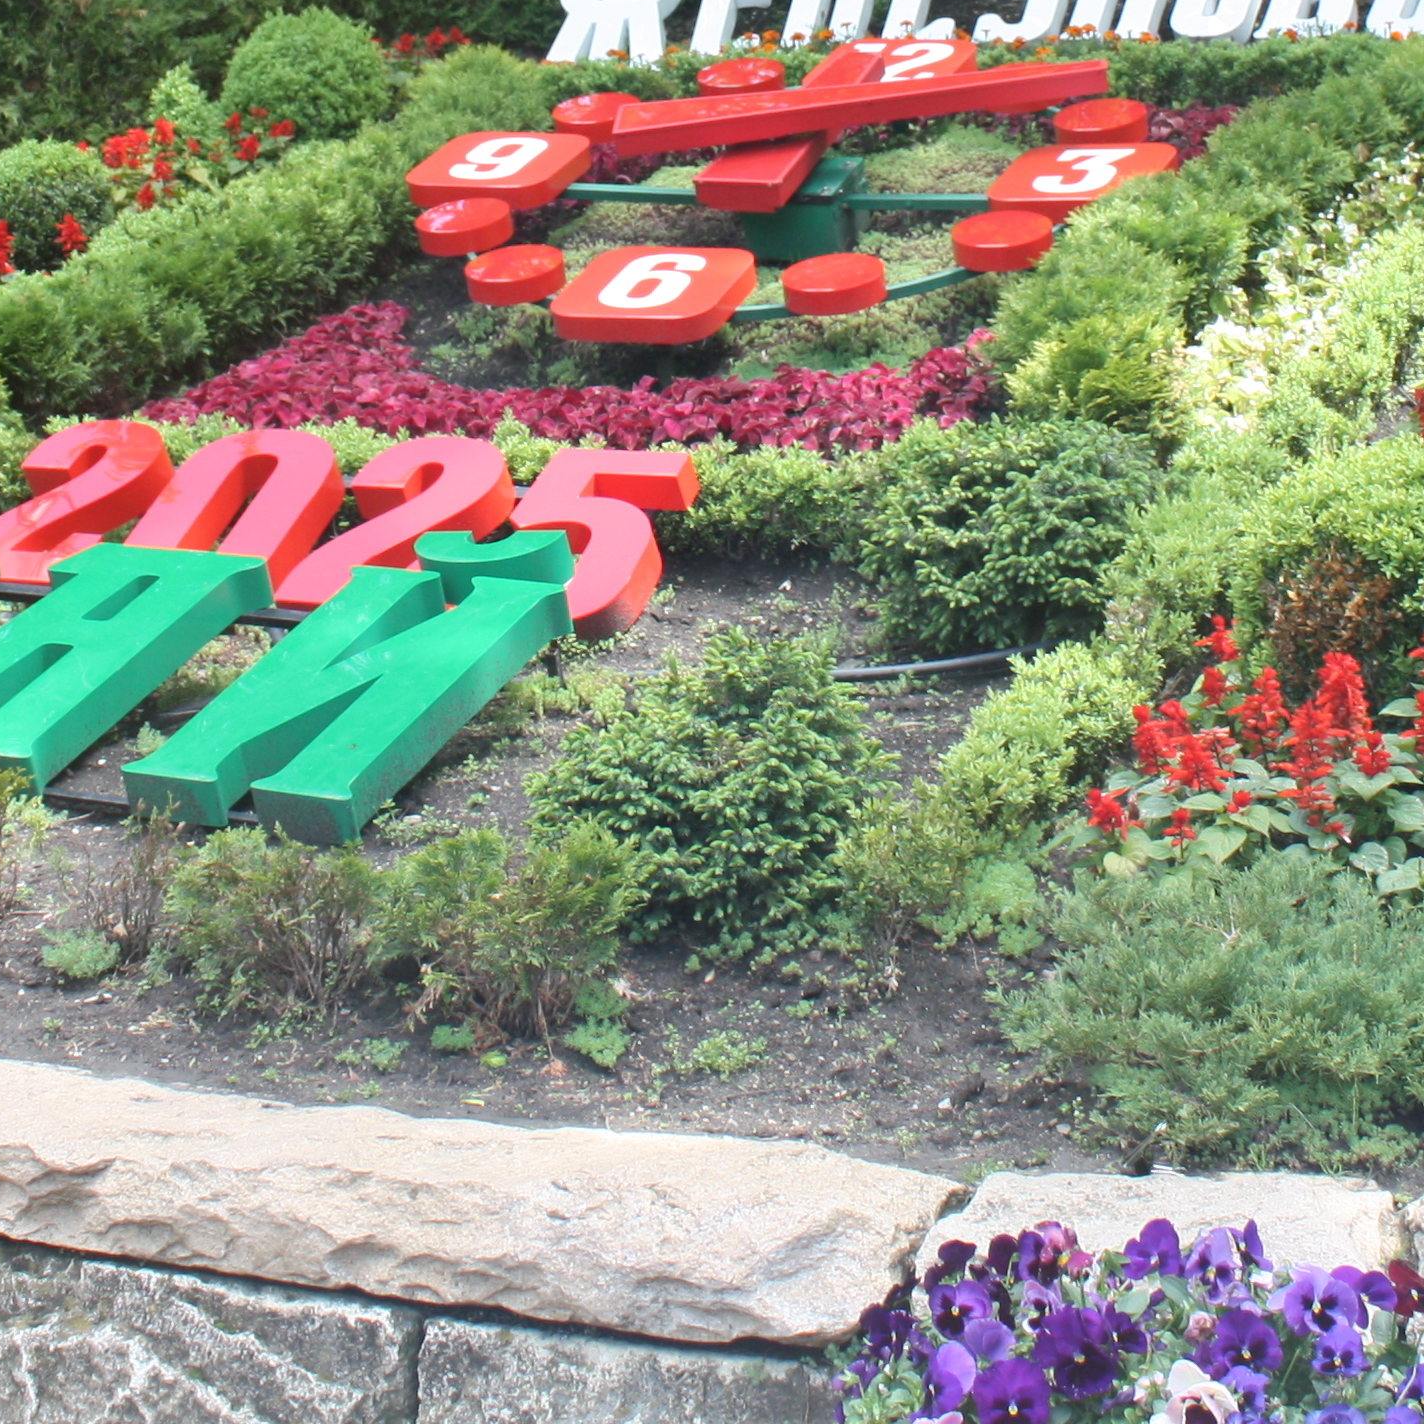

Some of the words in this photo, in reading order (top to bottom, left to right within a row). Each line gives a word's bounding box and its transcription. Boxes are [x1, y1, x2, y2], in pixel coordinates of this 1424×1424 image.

[853, 42, 955, 83] 2
[448, 136, 549, 179] 9
[1031, 147, 1137, 193] 3
[597, 253, 707, 308] 6
